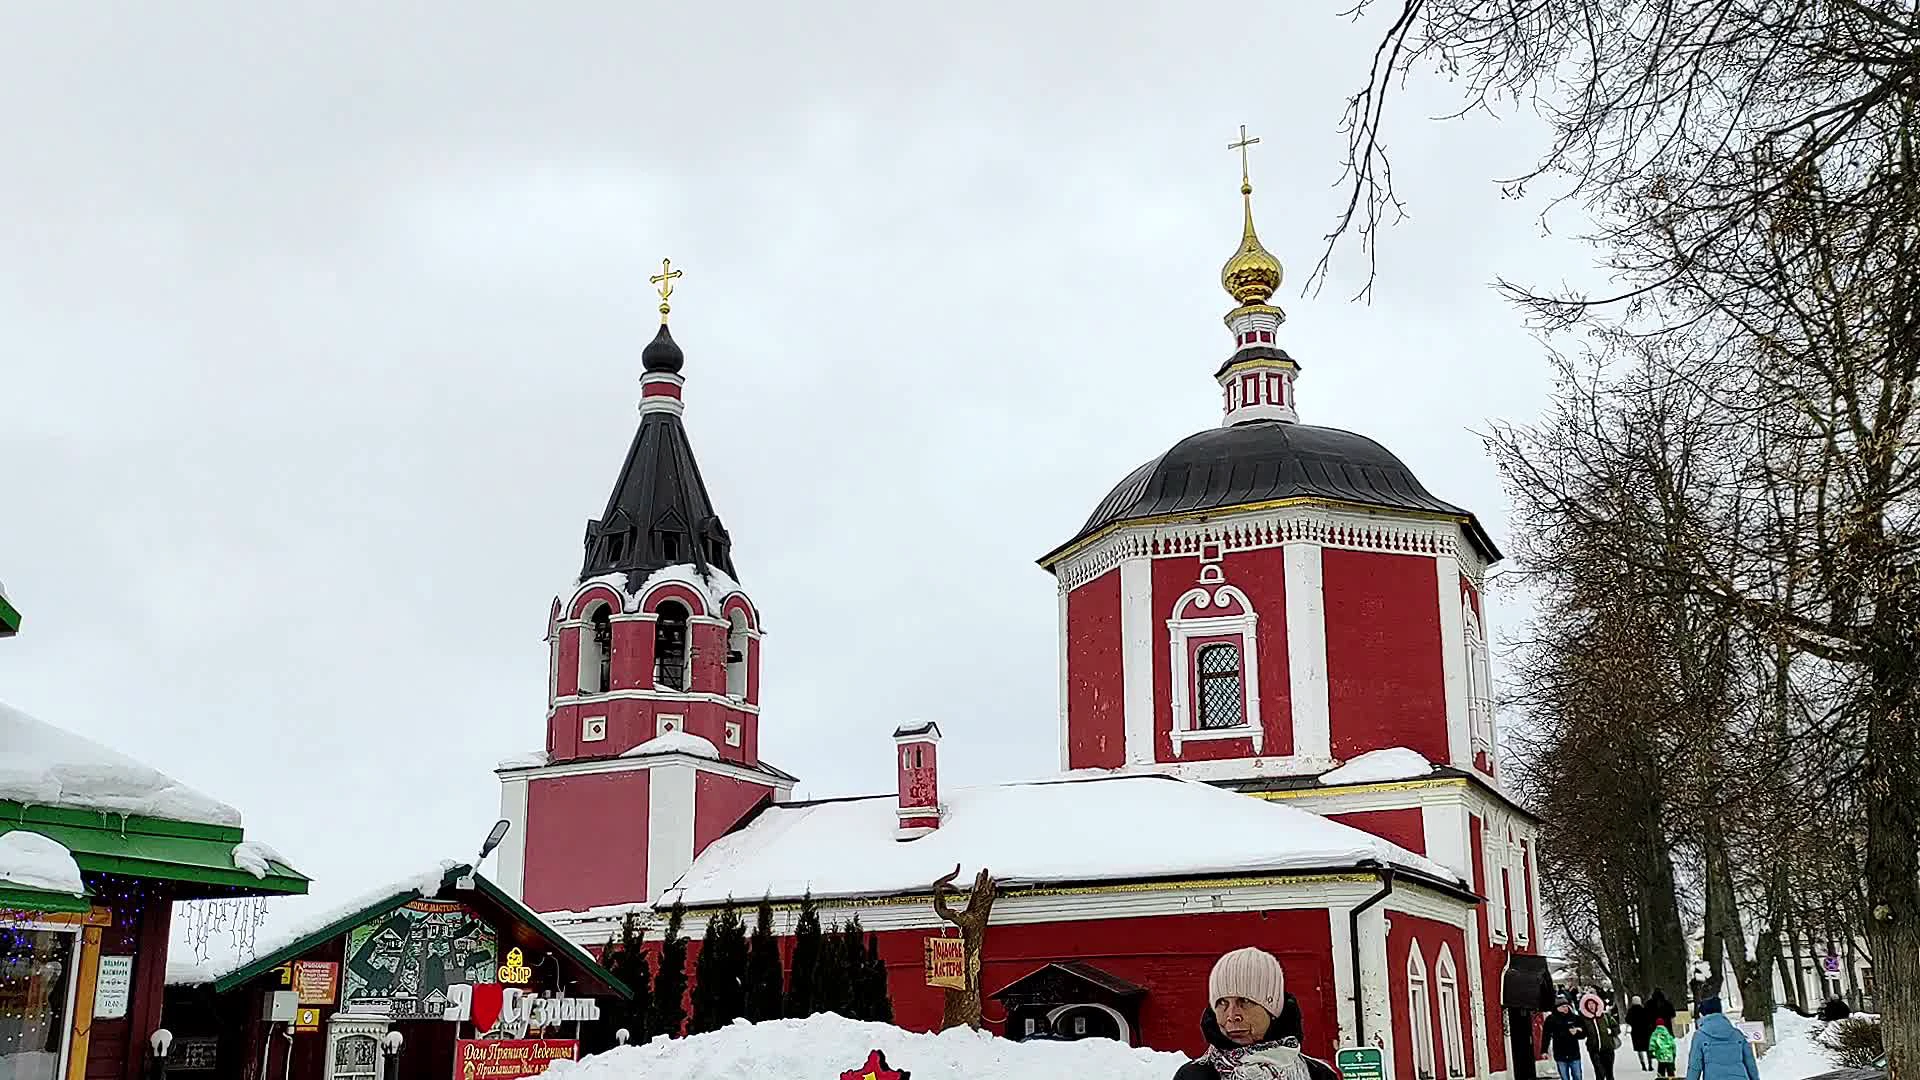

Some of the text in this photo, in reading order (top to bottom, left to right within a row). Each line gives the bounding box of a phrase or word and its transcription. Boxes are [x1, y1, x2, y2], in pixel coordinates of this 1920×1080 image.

[498, 966, 532, 984] СЫР
[443, 983, 601, 1039] Я Суздаль
[463, 1043, 487, 1061] Дом
[488, 1042, 529, 1065] Пряника
